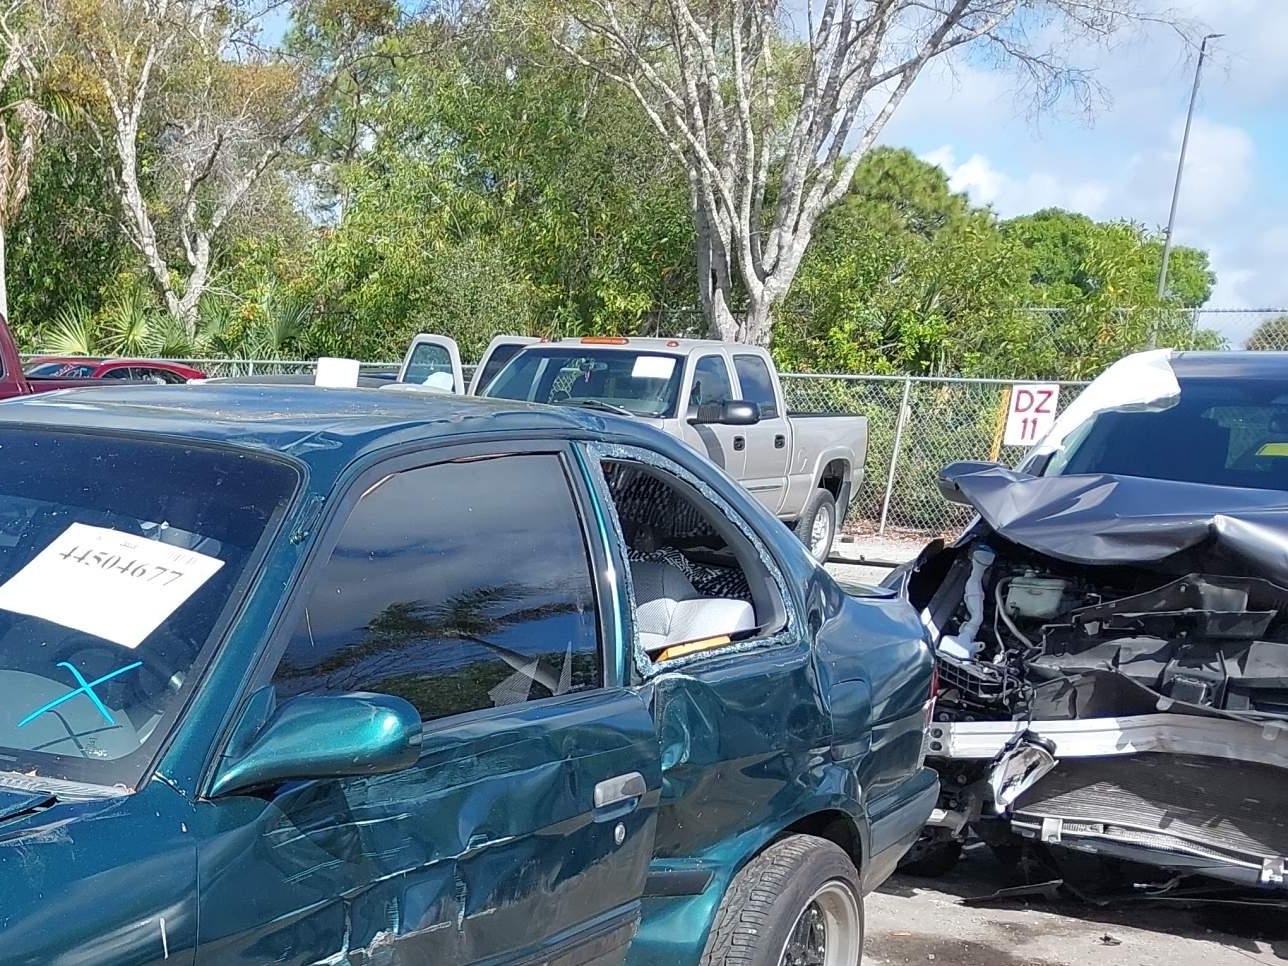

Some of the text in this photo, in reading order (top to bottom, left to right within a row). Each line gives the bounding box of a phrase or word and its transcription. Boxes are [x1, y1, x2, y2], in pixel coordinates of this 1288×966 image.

[1015, 389, 1054, 414] DZ
[1020, 418, 1038, 440] 11
[59, 546, 184, 586] 44504677
